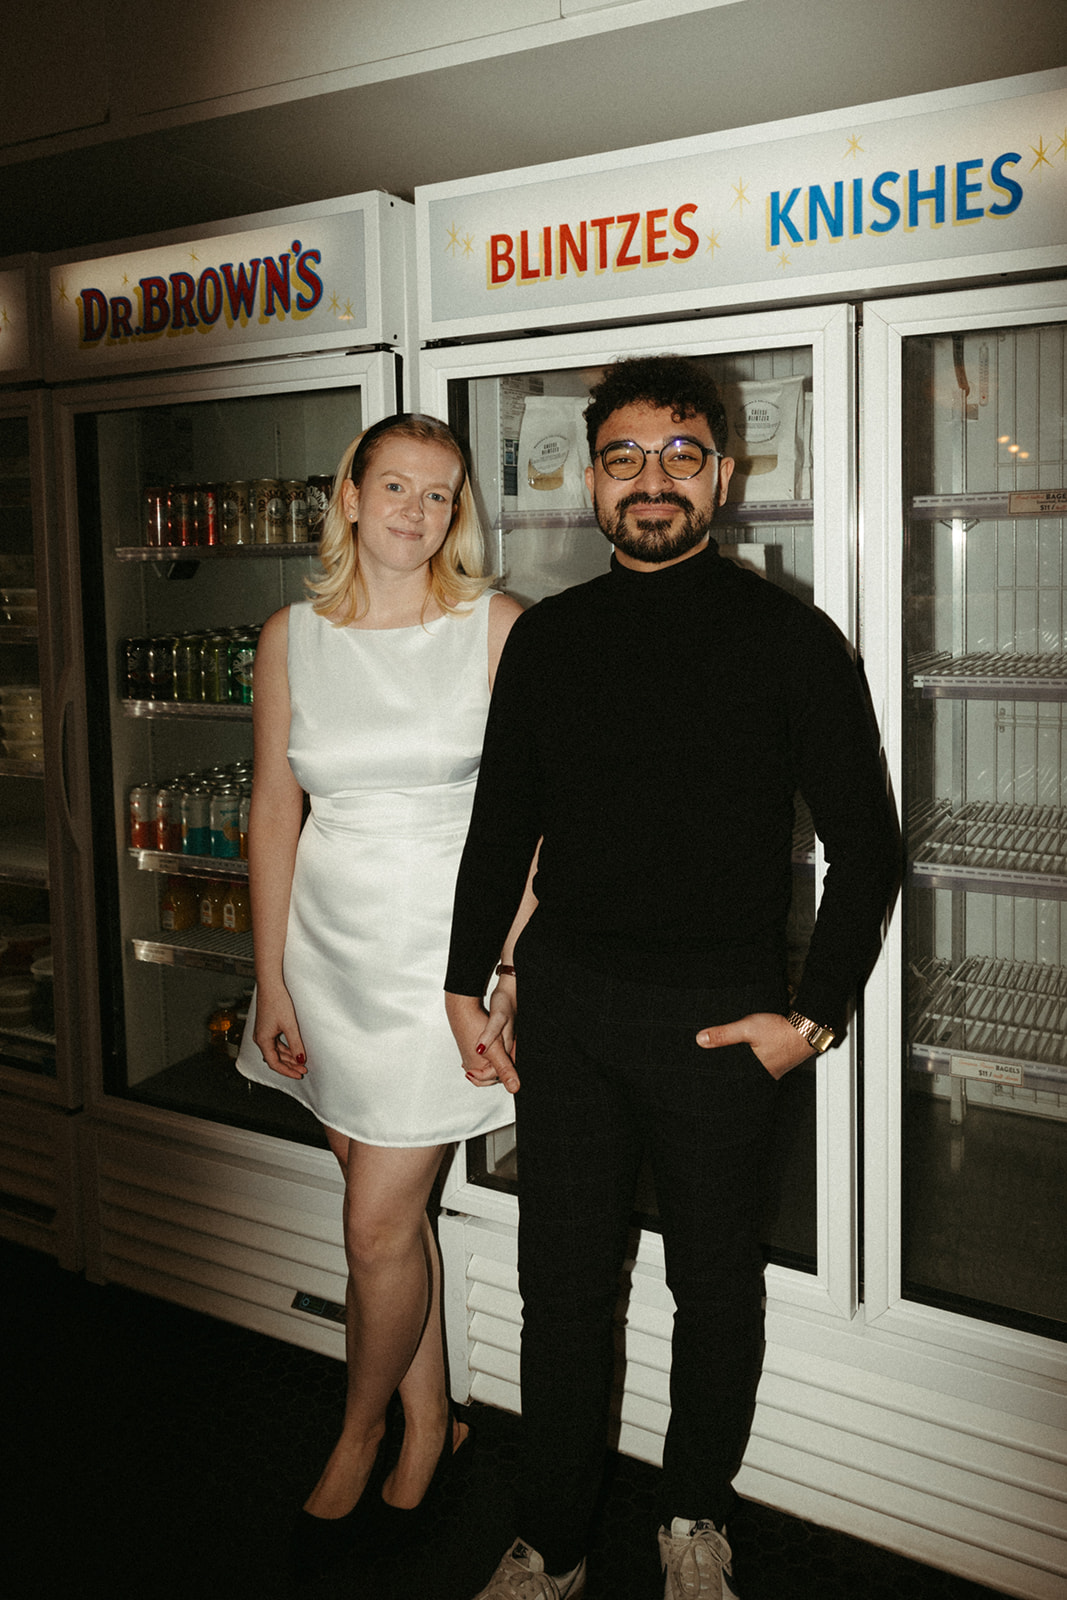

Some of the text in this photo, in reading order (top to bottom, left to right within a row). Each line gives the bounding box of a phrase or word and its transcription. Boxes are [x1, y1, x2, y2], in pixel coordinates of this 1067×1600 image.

[489, 151, 1024, 284] BLINTZES KNISHES
[995, 1064, 1020, 1074] BAGELS
